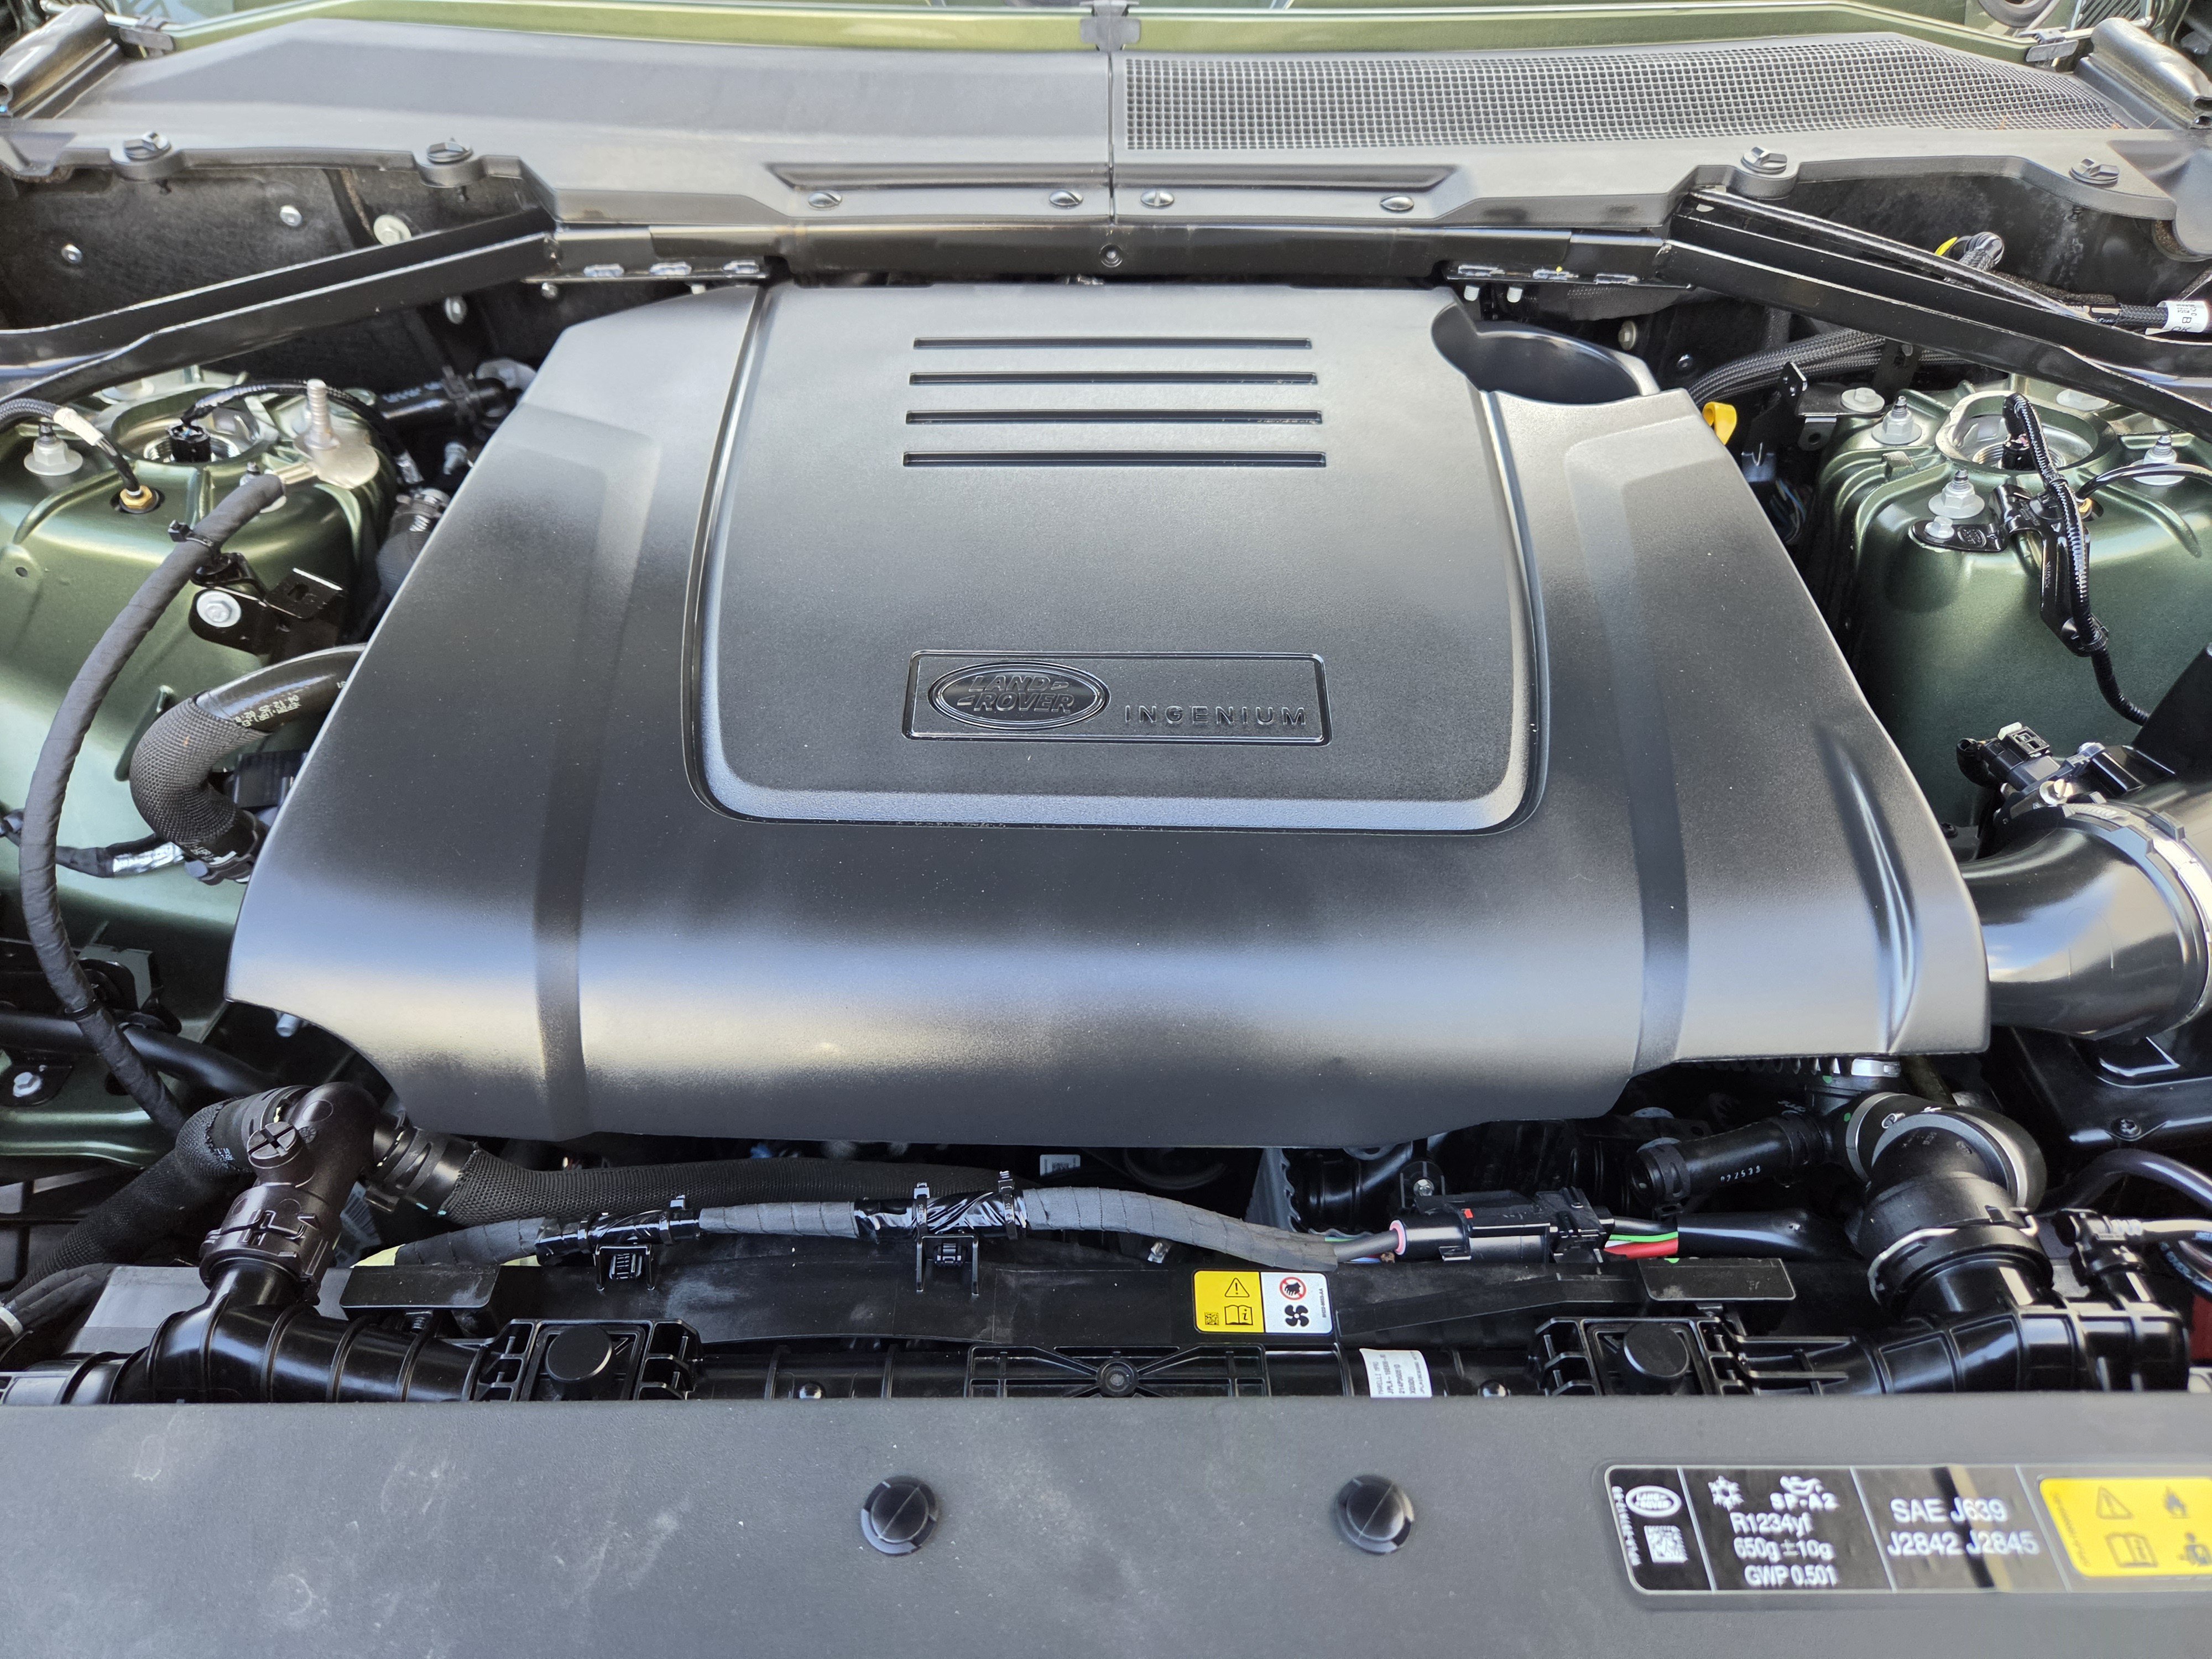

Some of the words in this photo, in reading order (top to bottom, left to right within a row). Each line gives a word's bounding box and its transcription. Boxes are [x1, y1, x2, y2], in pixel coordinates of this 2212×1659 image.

[968, 675, 1051, 692] LAND
[974, 692, 1074, 712] ROVER
[1124, 704, 1307, 726] INGENIUM
[1890, 1498, 1948, 1523] SAE
[1950, 1496, 2008, 1522] J639
[1730, 1512, 1814, 1538] R1234yf
[1734, 1537, 1782, 1563] 650g
[1887, 1531, 1963, 1557] J2842
[1966, 1530, 2040, 1556] J2845
[1744, 1564, 1790, 1587] GWP
[1790, 1564, 1839, 1587] 0.501
